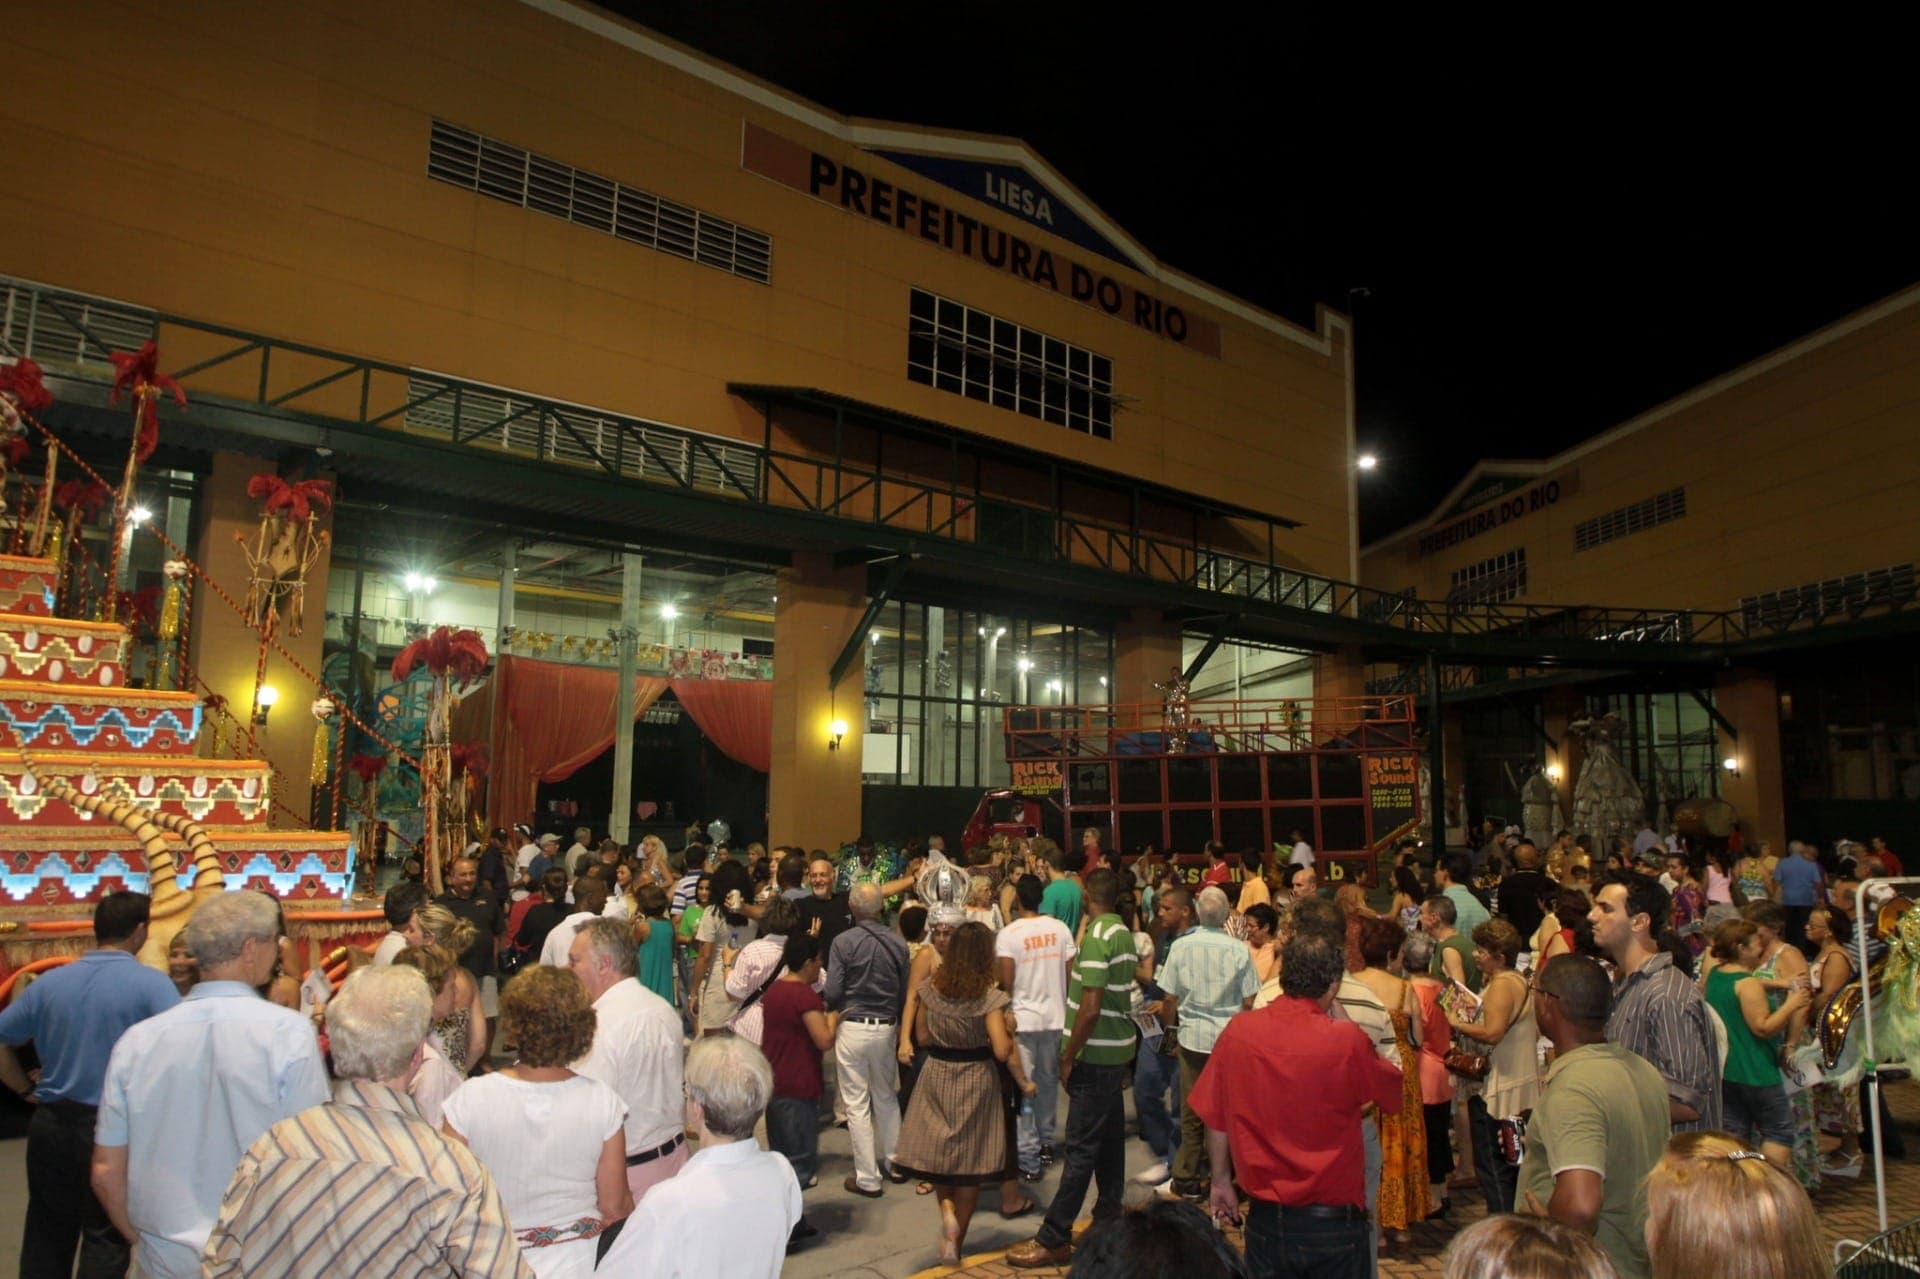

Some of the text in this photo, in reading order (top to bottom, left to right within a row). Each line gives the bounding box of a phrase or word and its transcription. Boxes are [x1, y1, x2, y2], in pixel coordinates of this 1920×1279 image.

[985, 170, 1054, 226] LIESA
[810, 152, 1188, 341] PREFEITURA DO RIO
[1501, 496, 1524, 523] DO
[1531, 479, 1560, 511] RIO
[1013, 761, 1059, 776] RICK
[1368, 757, 1415, 773] RICK
[1023, 933, 1057, 952] STAFF
